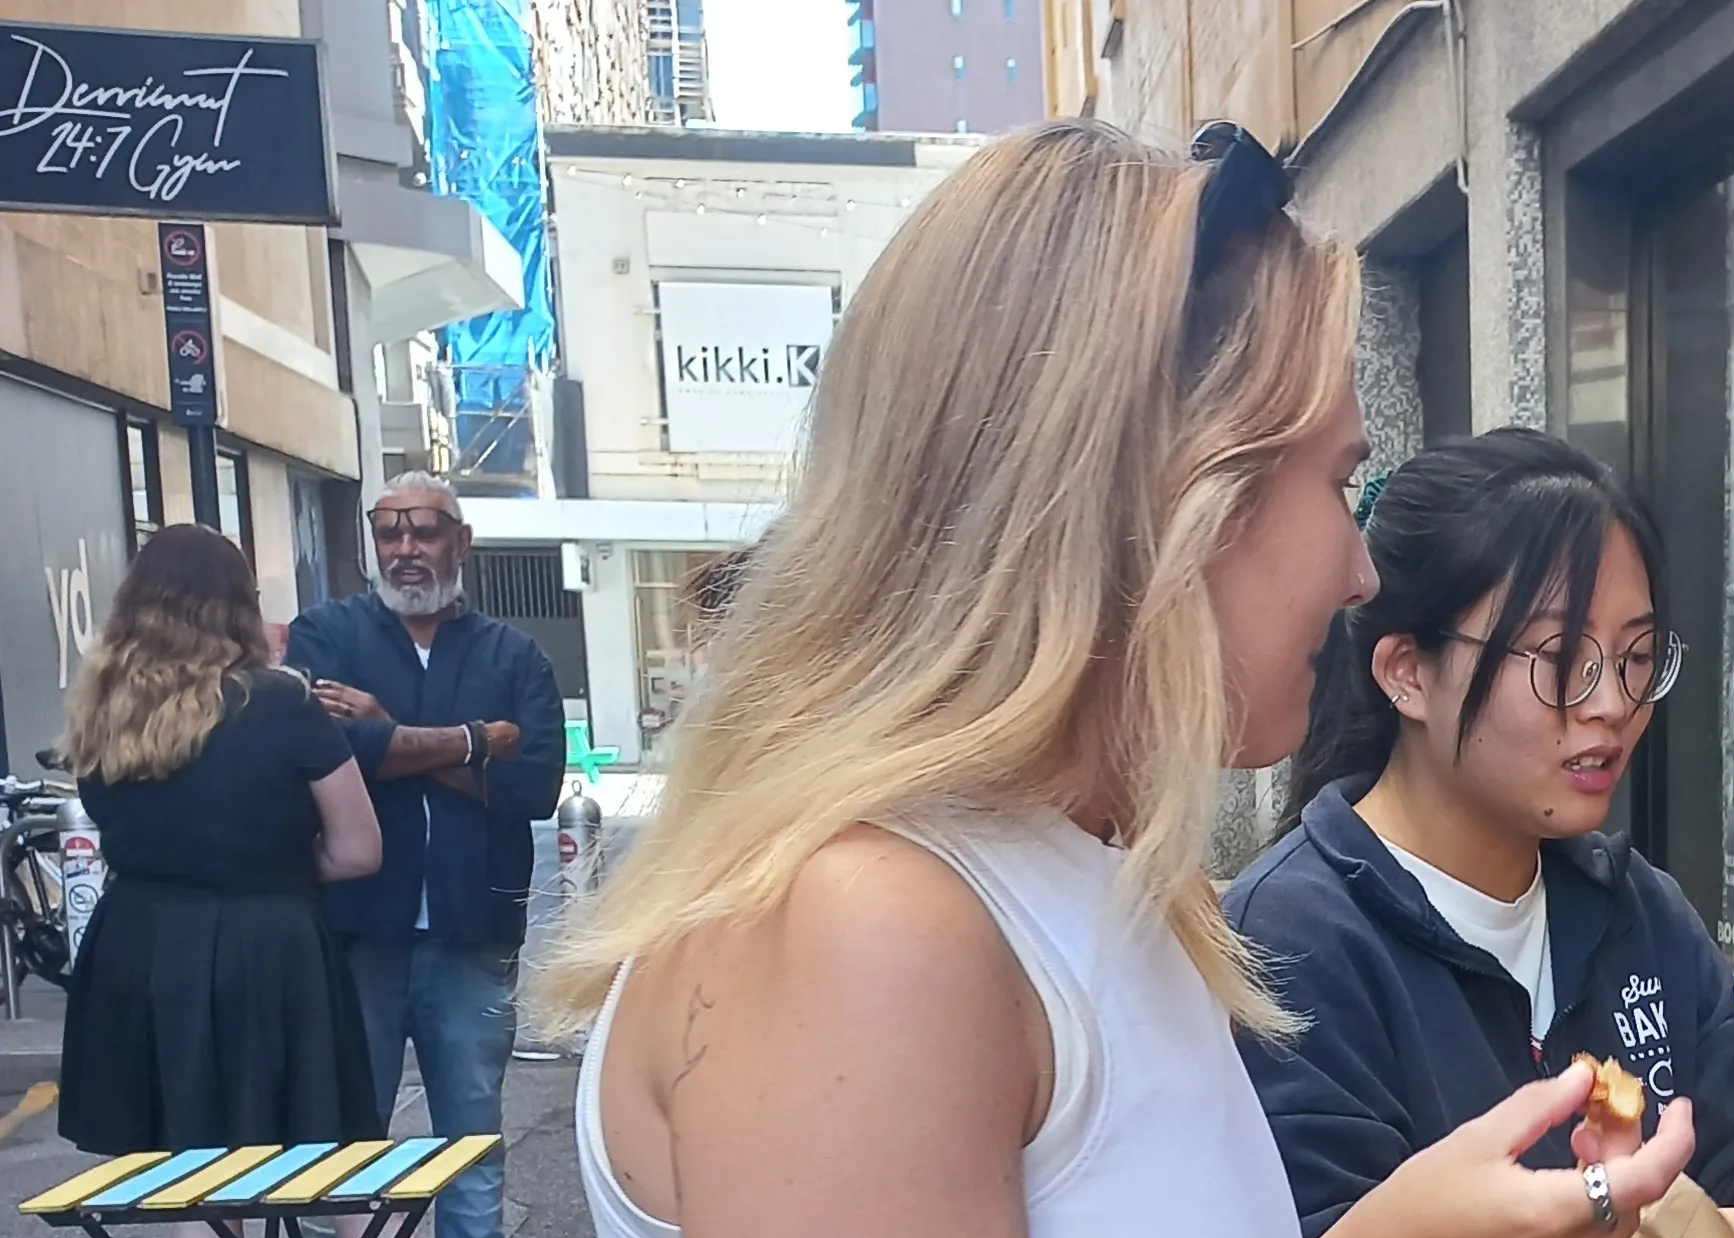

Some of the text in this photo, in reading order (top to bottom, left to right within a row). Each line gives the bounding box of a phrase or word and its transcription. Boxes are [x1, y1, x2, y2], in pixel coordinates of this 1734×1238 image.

[0, 34, 289, 146] Derrimut
[128, 114, 241, 201] Gym
[677, 344, 820, 387] kikki.K
